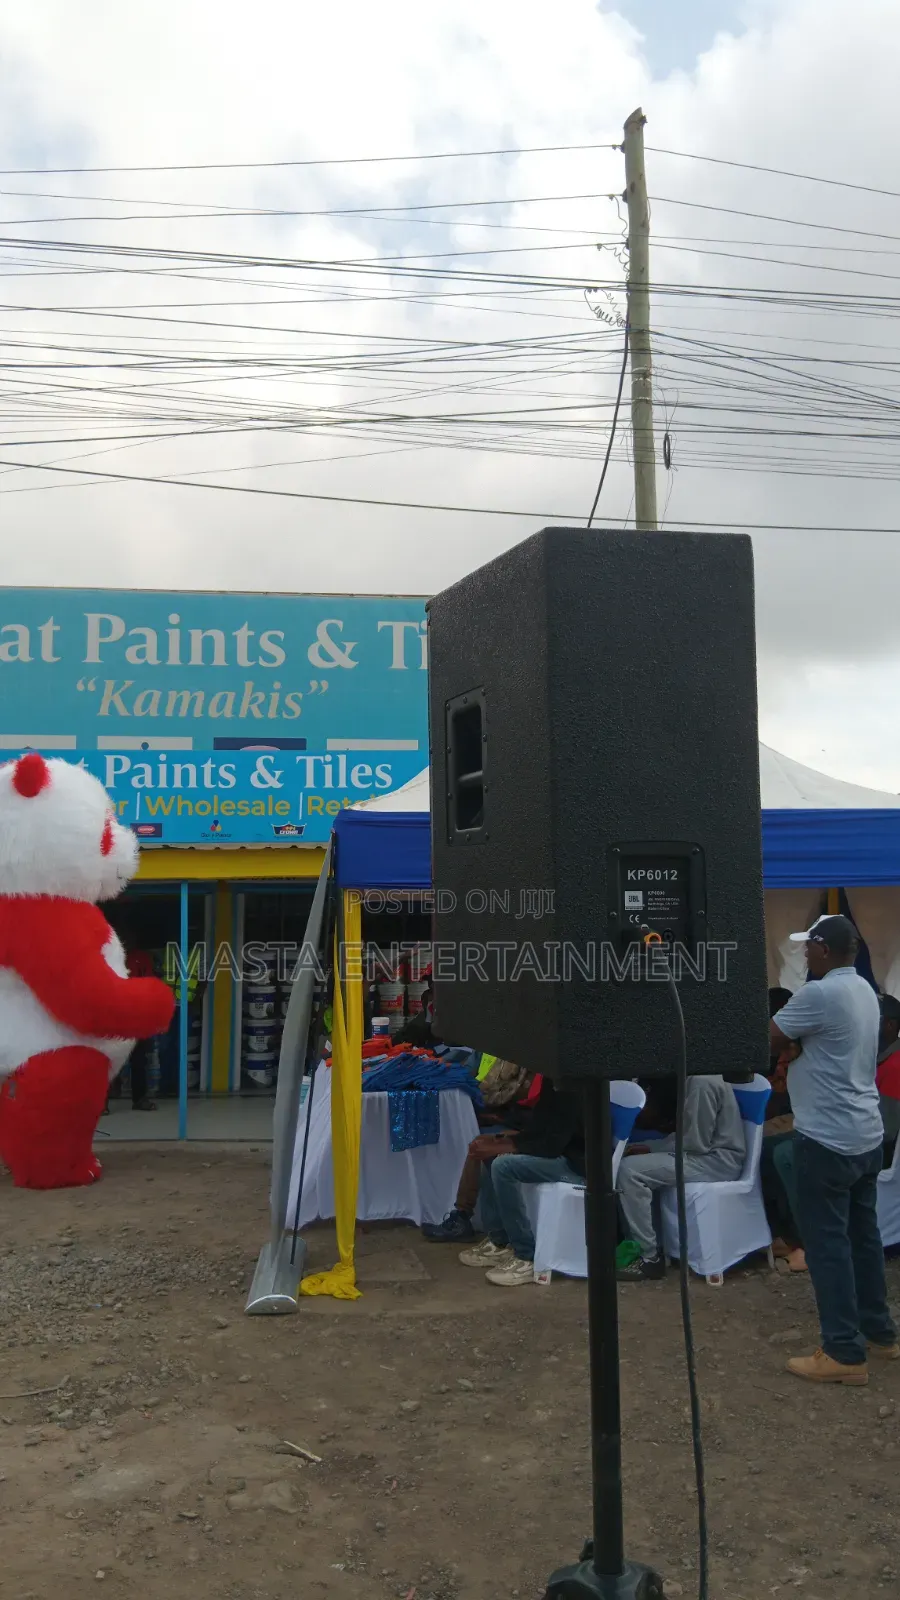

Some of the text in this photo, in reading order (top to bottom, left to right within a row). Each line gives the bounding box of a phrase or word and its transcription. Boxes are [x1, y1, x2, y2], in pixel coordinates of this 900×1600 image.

[0, 615, 62, 663] at
[81, 613, 287, 668] Paints
[307, 619, 360, 669] &
[104, 754, 393, 789] Paints & Tiles
[145, 795, 291, 816] Wholesale
[307, 794, 382, 816] Ret
[627, 869, 678, 880] KP6012
